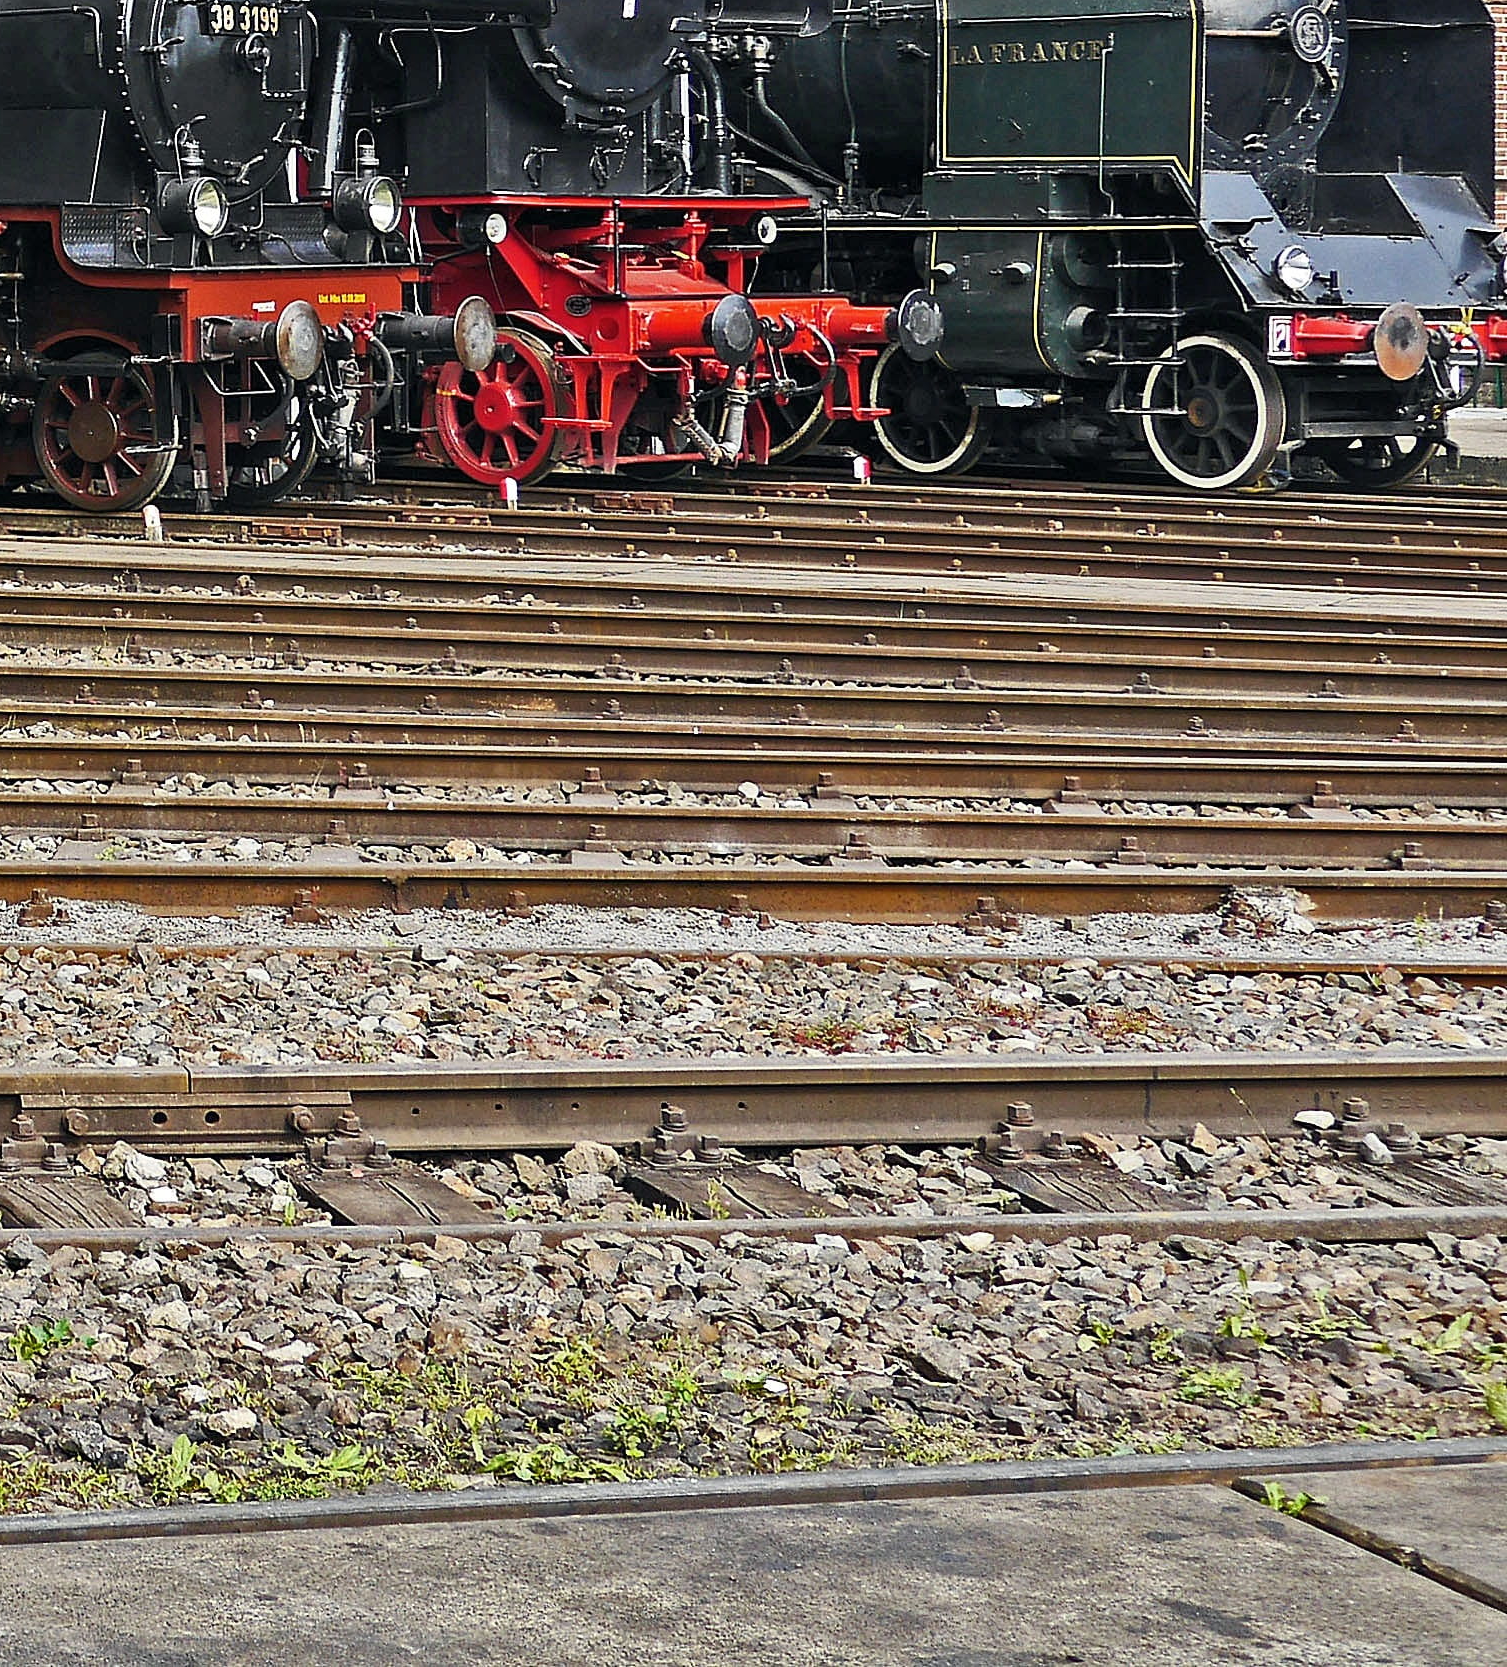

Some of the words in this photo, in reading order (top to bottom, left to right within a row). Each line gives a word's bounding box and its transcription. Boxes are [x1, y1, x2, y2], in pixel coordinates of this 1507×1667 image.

[210, 3, 235, 31] 38
[239, 5, 279, 32] 3199
[949, 45, 985, 66] LA
[988, 39, 1104, 64] FRANCE
